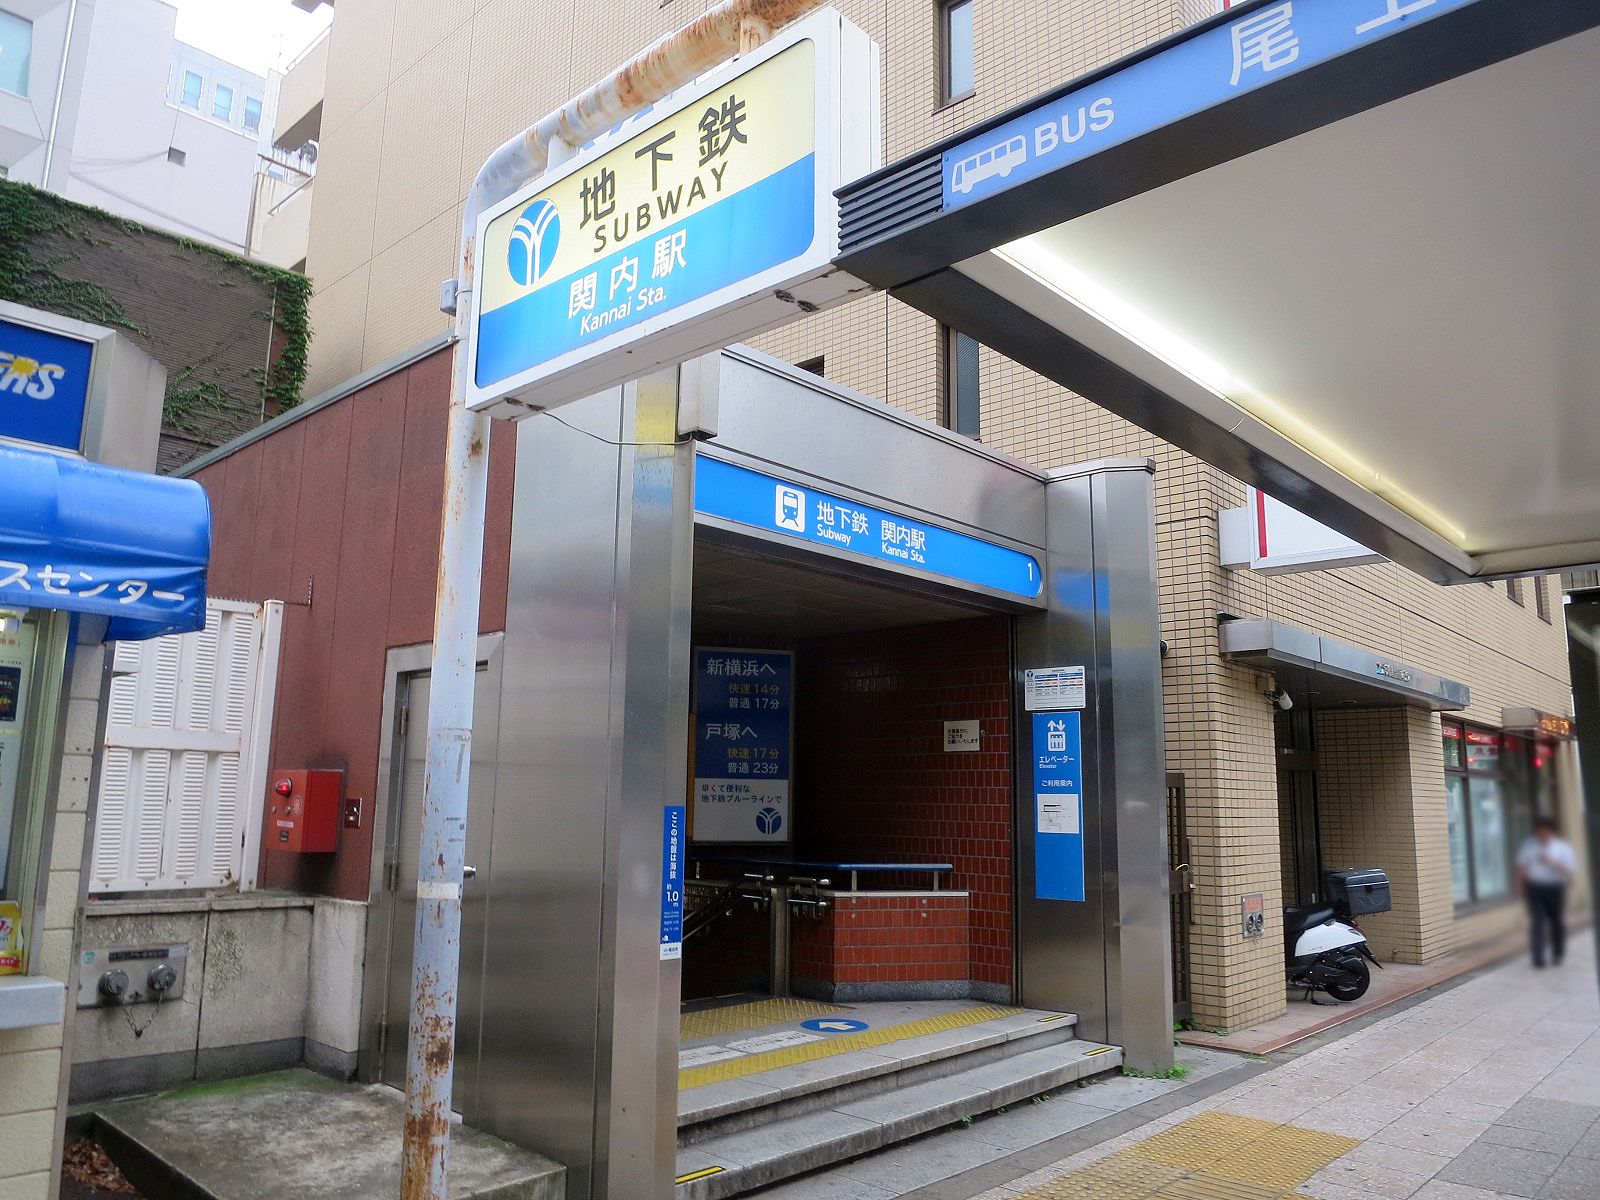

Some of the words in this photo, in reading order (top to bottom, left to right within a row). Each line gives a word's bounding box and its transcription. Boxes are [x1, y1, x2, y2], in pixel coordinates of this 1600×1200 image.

[1035, 96, 1116, 158] BUS
[579, 94, 748, 230] 地下鉄
[593, 161, 728, 253] SUBWAY
[568, 228, 688, 319] 関内駅
[580, 298, 632, 336] Kannai
[636, 286, 668, 311] Sta.
[816, 500, 869, 536] 地下鉄
[881, 519, 926, 551] 関内駅
[816, 524, 852, 546] Subway
[881, 542, 909, 560] Kannai
[910, 550, 926, 564] Sta.
[1027, 562, 1034, 581] 1
[0, 560, 185, 605] スセンター
[706, 658, 776, 677] 新横浜へ
[728, 683, 751, 695] 快速
[754, 683, 780, 696] 14分
[728, 697, 751, 709] 普通
[754, 698, 780, 710] 17分
[705, 723, 758, 741] 戸塚へ
[727, 747, 750, 760] 快速
[752, 748, 780, 760] 17分
[1039, 755, 1075, 764] エレベーター
[727, 762, 750, 774] 普通
[752, 762, 779, 774] 23分
[701, 784, 751, 793] 早くて便利な
[701, 795, 782, 804] 地下鉄ブルーラインで
[666, 890, 679, 902] 1.0
